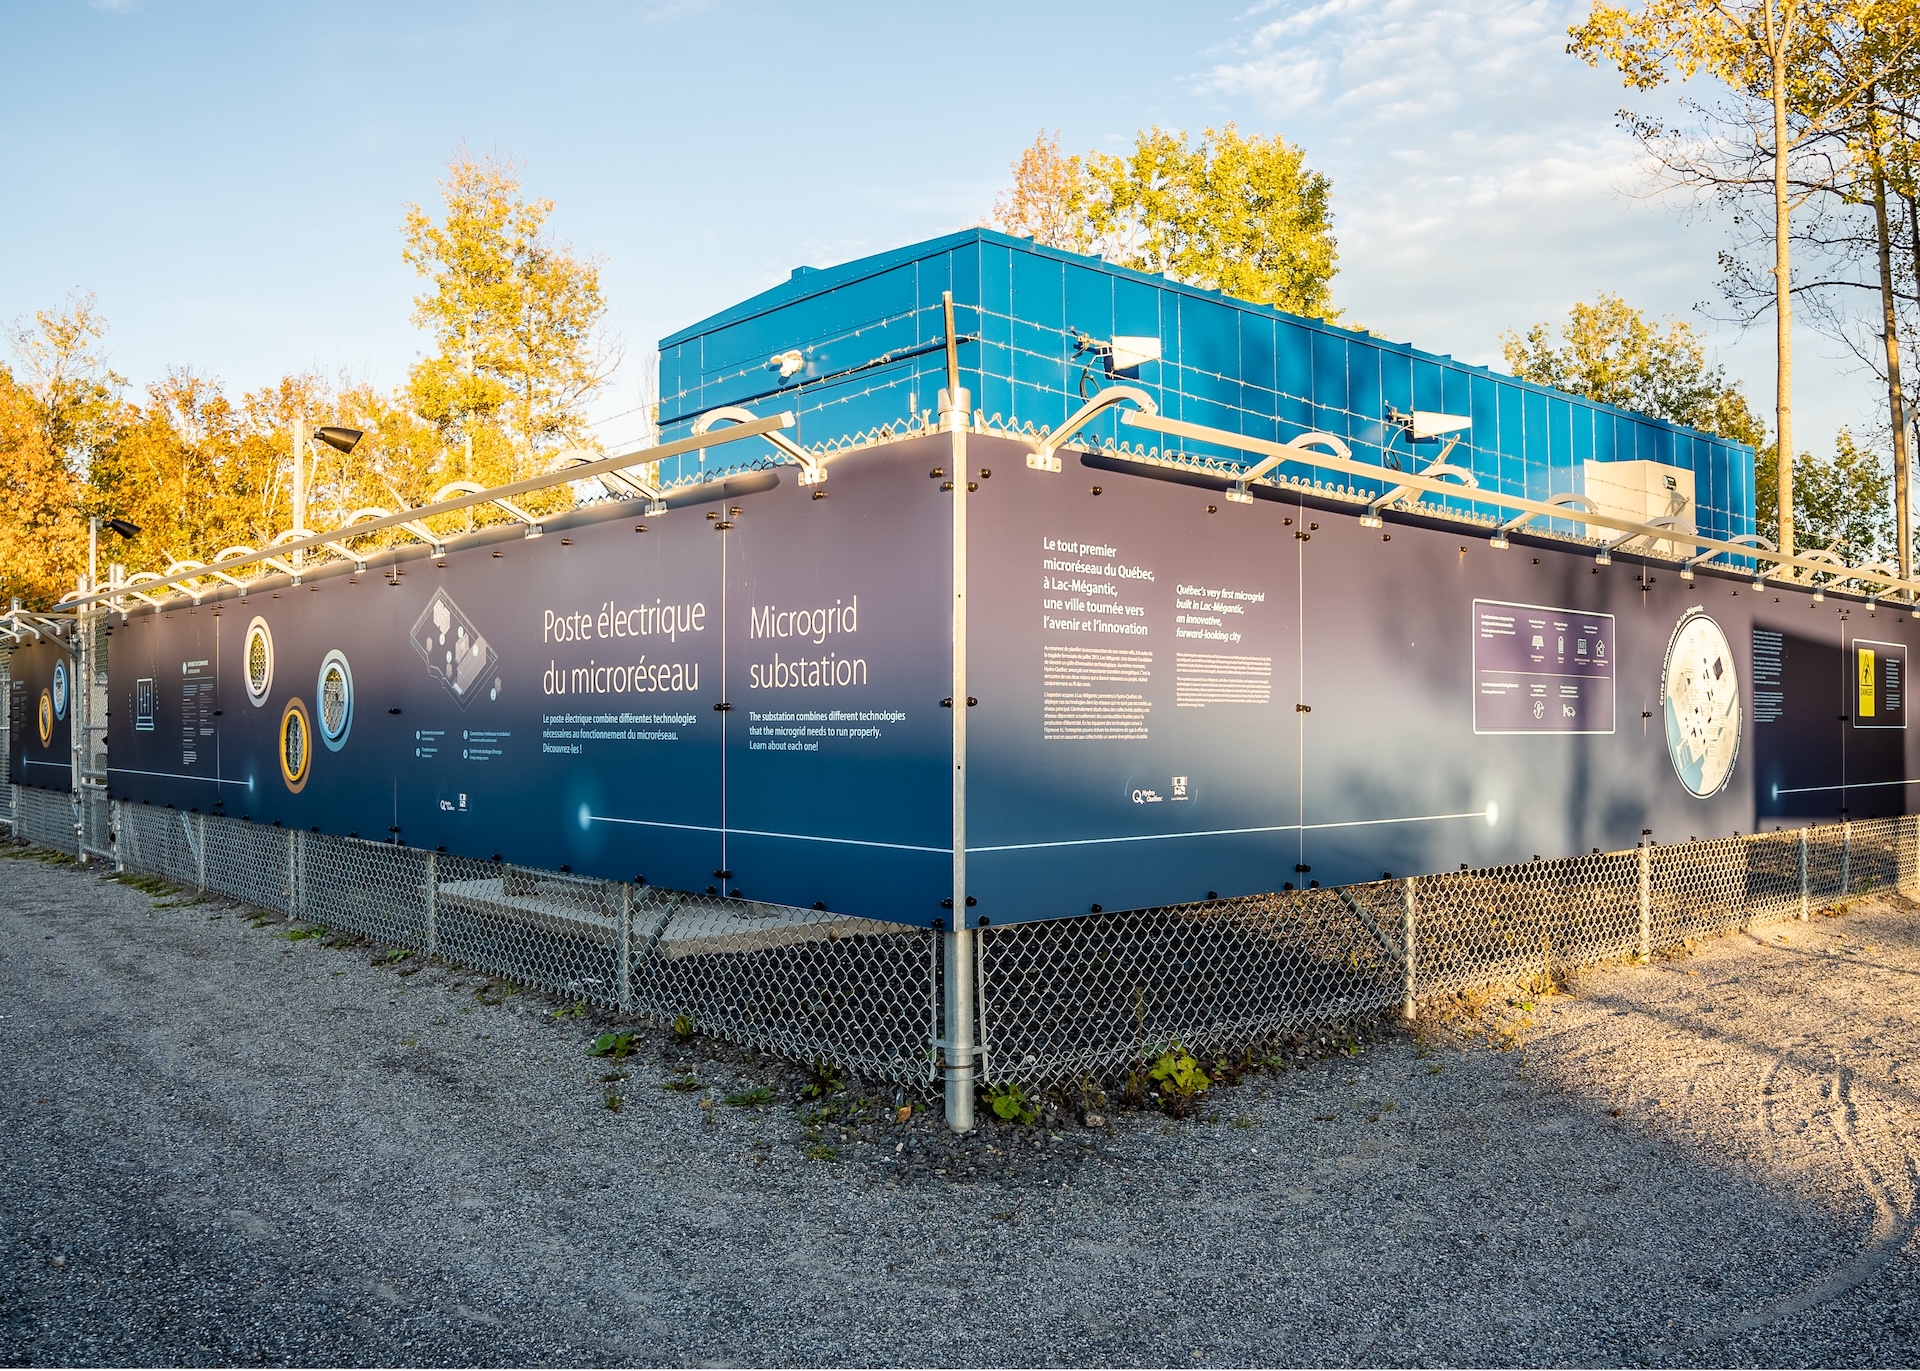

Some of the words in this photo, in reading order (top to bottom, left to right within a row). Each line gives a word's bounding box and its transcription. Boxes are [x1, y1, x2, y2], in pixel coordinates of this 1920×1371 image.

[1044, 536, 1056, 550] Le
[1057, 540, 1078, 554] tout
[1080, 544, 1116, 558] premier
[1044, 558, 1102, 576] microréseau
[1104, 563, 1116, 576] du
[1118, 565, 1156, 582] Québec,
[1044, 576, 1050, 589] à
[1052, 577, 1118, 597] Lac-Mégantic,
[1207, 590, 1220, 600] very
[1222, 588, 1234, 599] first
[1234, 590, 1264, 603] microgrid
[1044, 598, 1062, 610] une
[1064, 598, 1085, 612] ville
[1086, 601, 1123, 614] tournée
[1125, 606, 1144, 616] vers
[1176, 598, 1192, 610] built
[1193, 600, 1199, 610] in
[1200, 601, 1244, 616] Lac-Mégantic,
[544, 609, 593, 644] Poste
[597, 598, 706, 643] électrique
[750, 594, 858, 645] Microgrid
[1044, 615, 1080, 631] l’avenir
[1082, 620, 1092, 632] et
[1093, 619, 1148, 635] l’innovation
[1176, 615, 1186, 624] an
[1186, 614, 1222, 628] innovative,
[1176, 627, 1228, 642] forward-looking
[1230, 632, 1242, 643] city
[543, 660, 566, 695] du
[571, 655, 699, 694] microréseau
[750, 652, 867, 689] substation
[543, 714, 549, 723] Le
[550, 715, 564, 725] poste
[565, 714, 592, 726] électrique
[592, 713, 618, 724] combine
[619, 712, 652, 724] différentes
[653, 712, 697, 727] technologies
[750, 712, 761, 722] The
[762, 712, 795, 722] substation
[796, 712, 827, 722] combines
[828, 710, 858, 721] different
[859, 710, 906, 724] technologies
[543, 728, 572, 738] nécessaires
[580, 728, 626, 739] fonctionnement
[628, 729, 636, 740] du
[637, 729, 678, 740] microréseau.
[749, 726, 762, 736] that
[763, 726, 774, 736] the
[775, 726, 806, 738] microgrid
[807, 726, 827, 736] needs
[828, 728, 835, 736] to
[849, 726, 881, 739] properly.
[543, 743, 579, 754] Découvrez-les
[750, 741, 767, 750] Learn
[768, 741, 787, 750] about
[787, 741, 803, 751] each
[804, 742, 819, 751] one!
